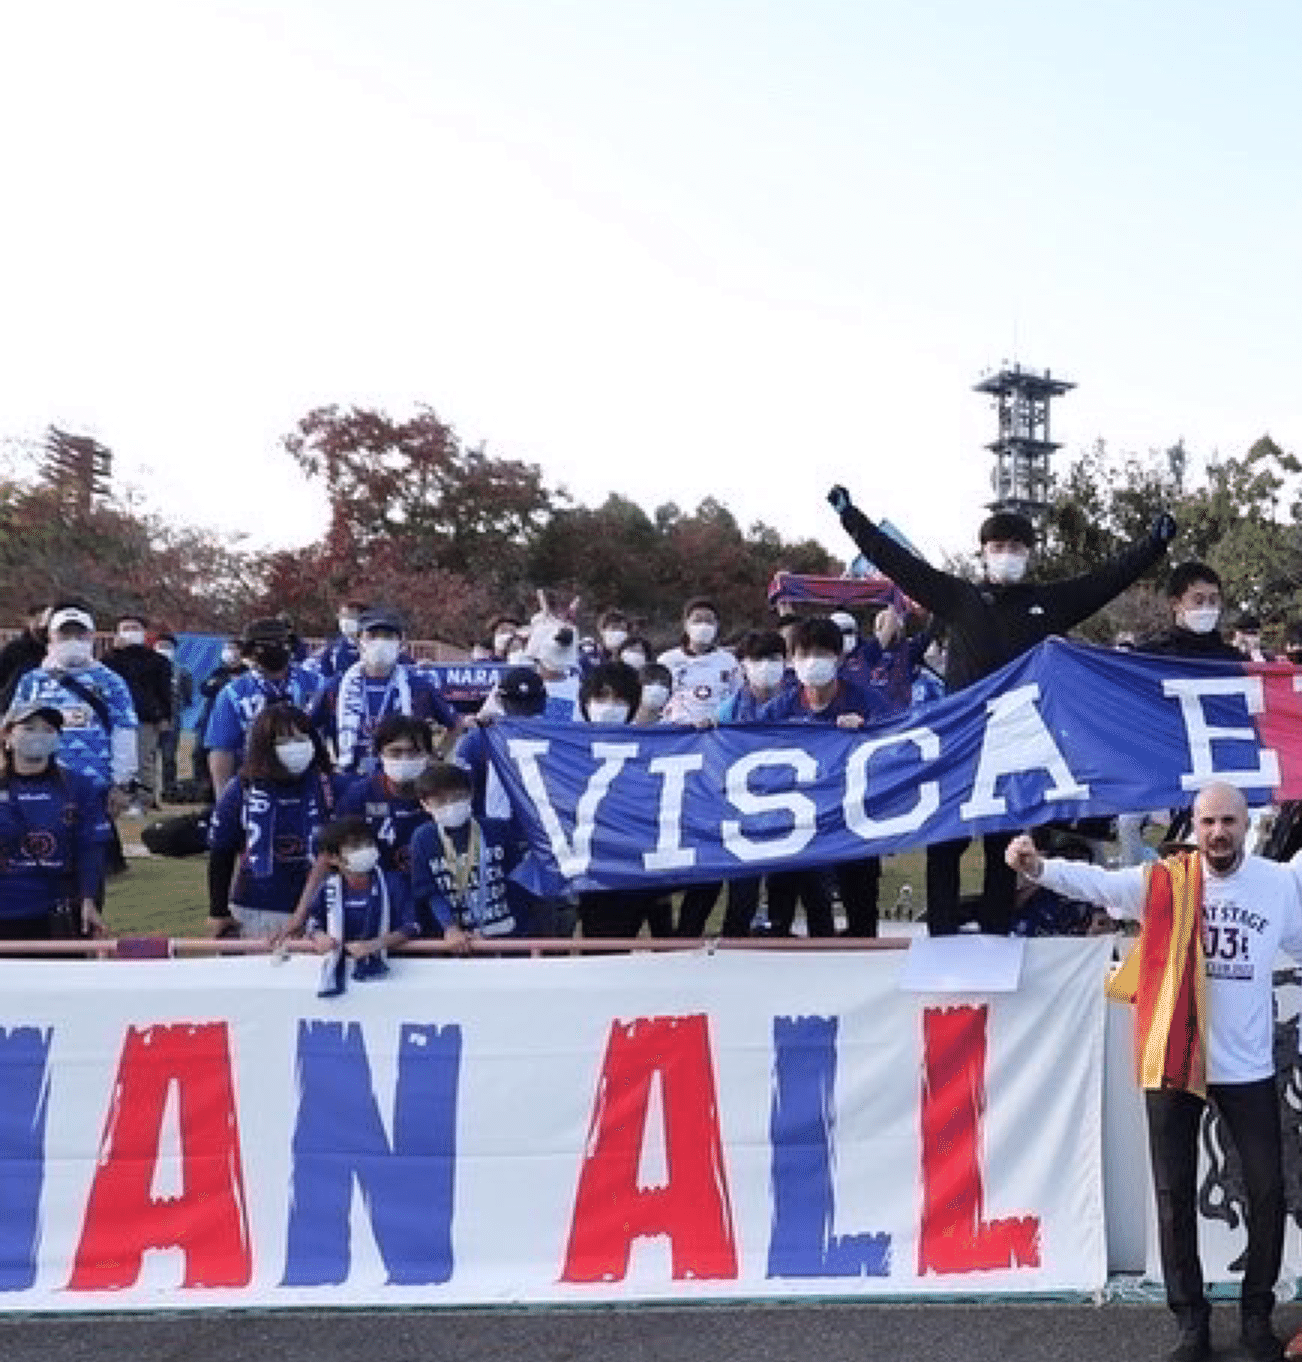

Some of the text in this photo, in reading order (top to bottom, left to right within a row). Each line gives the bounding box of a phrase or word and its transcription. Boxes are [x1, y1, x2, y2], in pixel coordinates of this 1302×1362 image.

[446, 668, 499, 684] NARA
[508, 683, 1090, 879] VISCA
[557, 1002, 1043, 1283] ALL
